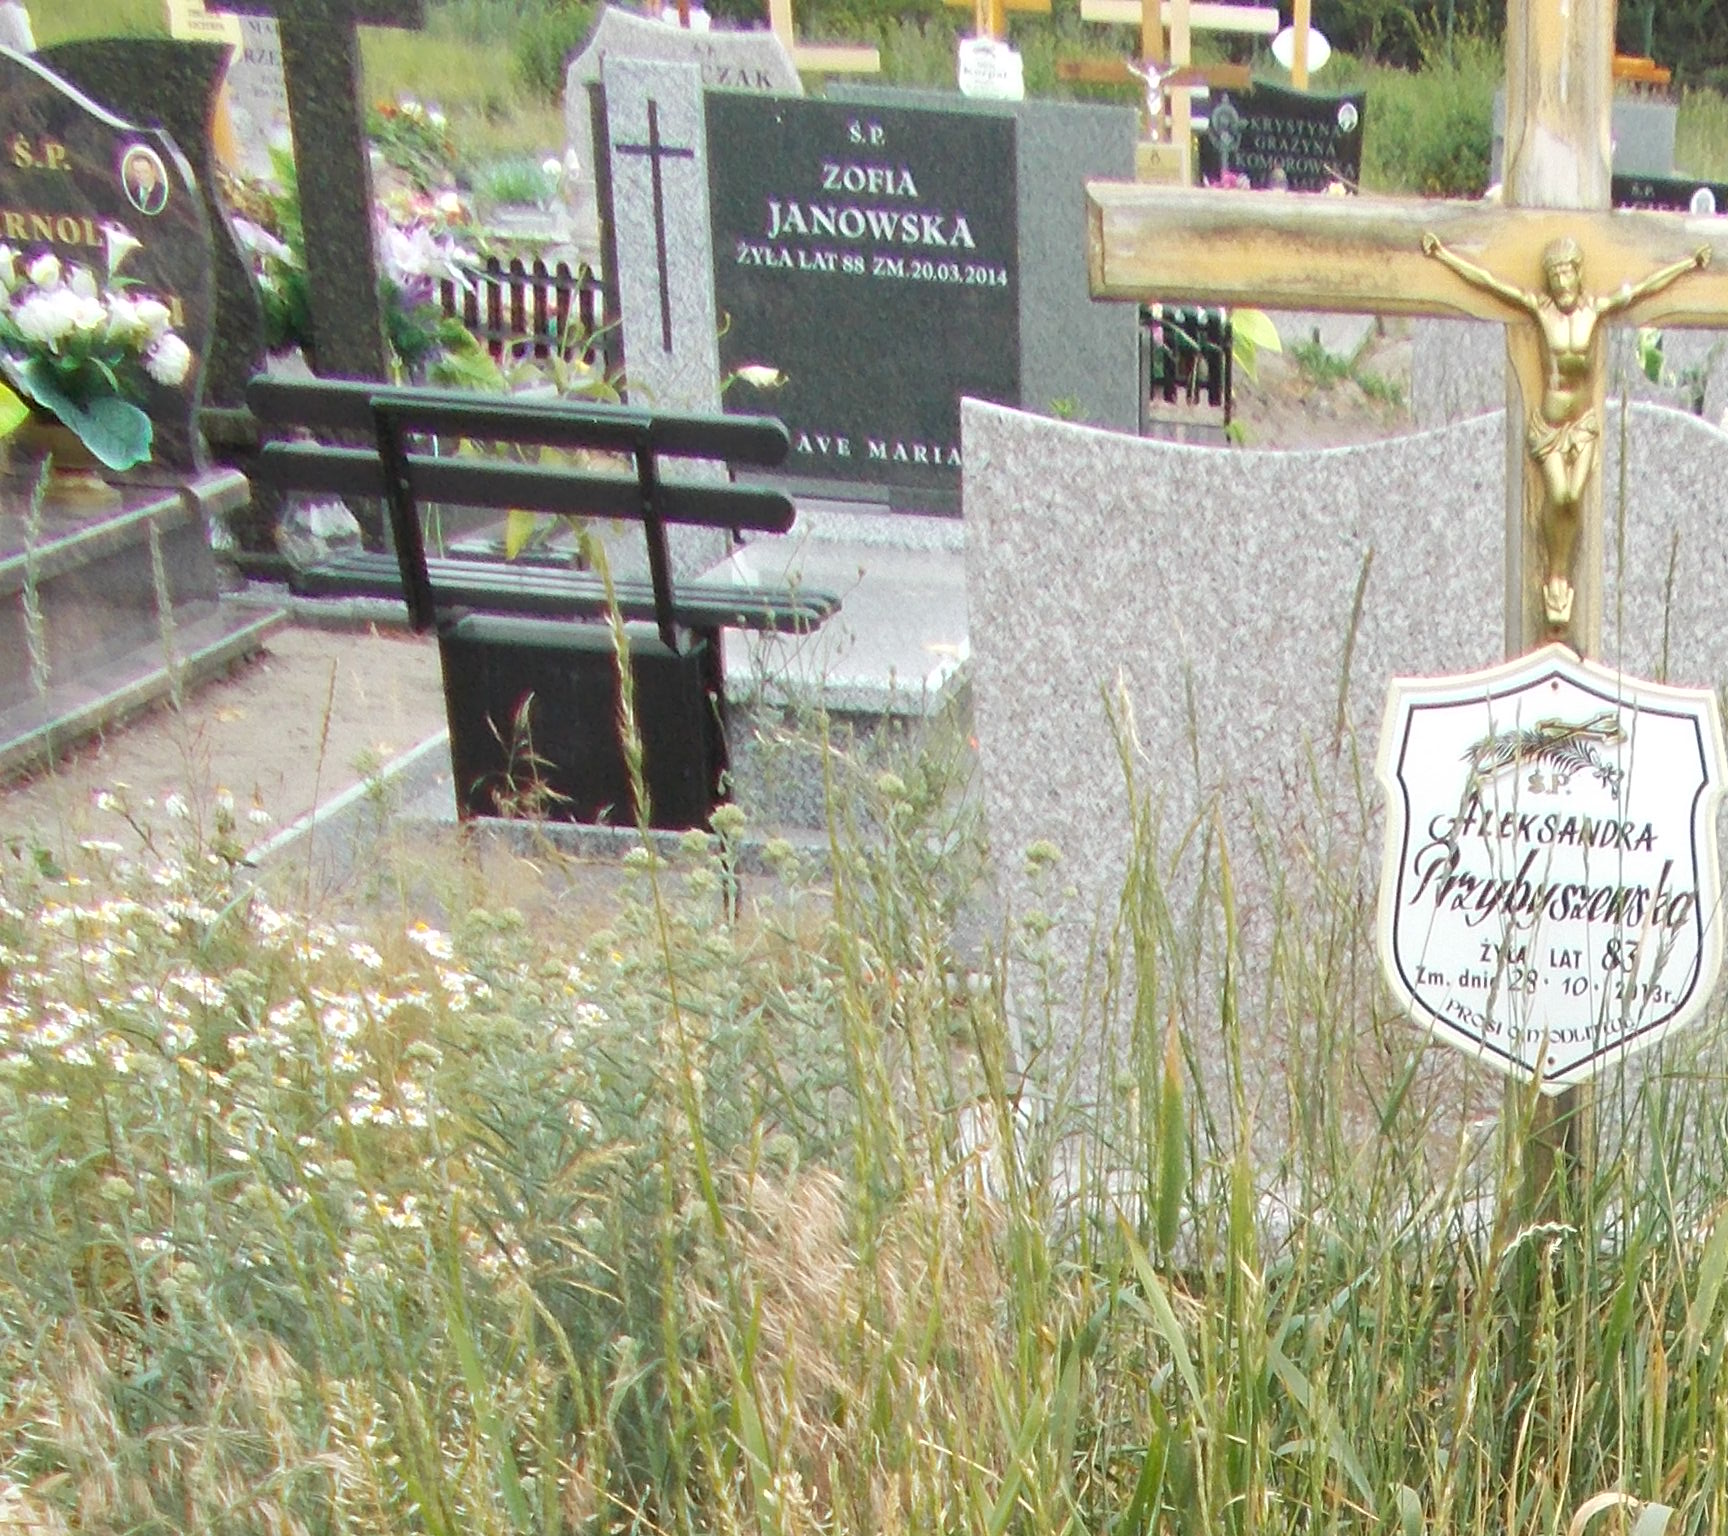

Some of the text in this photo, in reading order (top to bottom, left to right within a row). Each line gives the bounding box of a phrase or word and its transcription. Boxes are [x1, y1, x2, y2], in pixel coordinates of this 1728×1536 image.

[13, 132, 72, 171] Ś.P.
[823, 163, 920, 198] ZOFIA
[0, 211, 104, 248] RNOL
[767, 200, 977, 249] JANOWSKA
[797, 249, 838, 273] LAT
[842, 255, 866, 275] 88
[797, 433, 963, 467] AVE MARIA
[1416, 964, 1451, 987] Zm.
[1550, 947, 1583, 970] LAT
